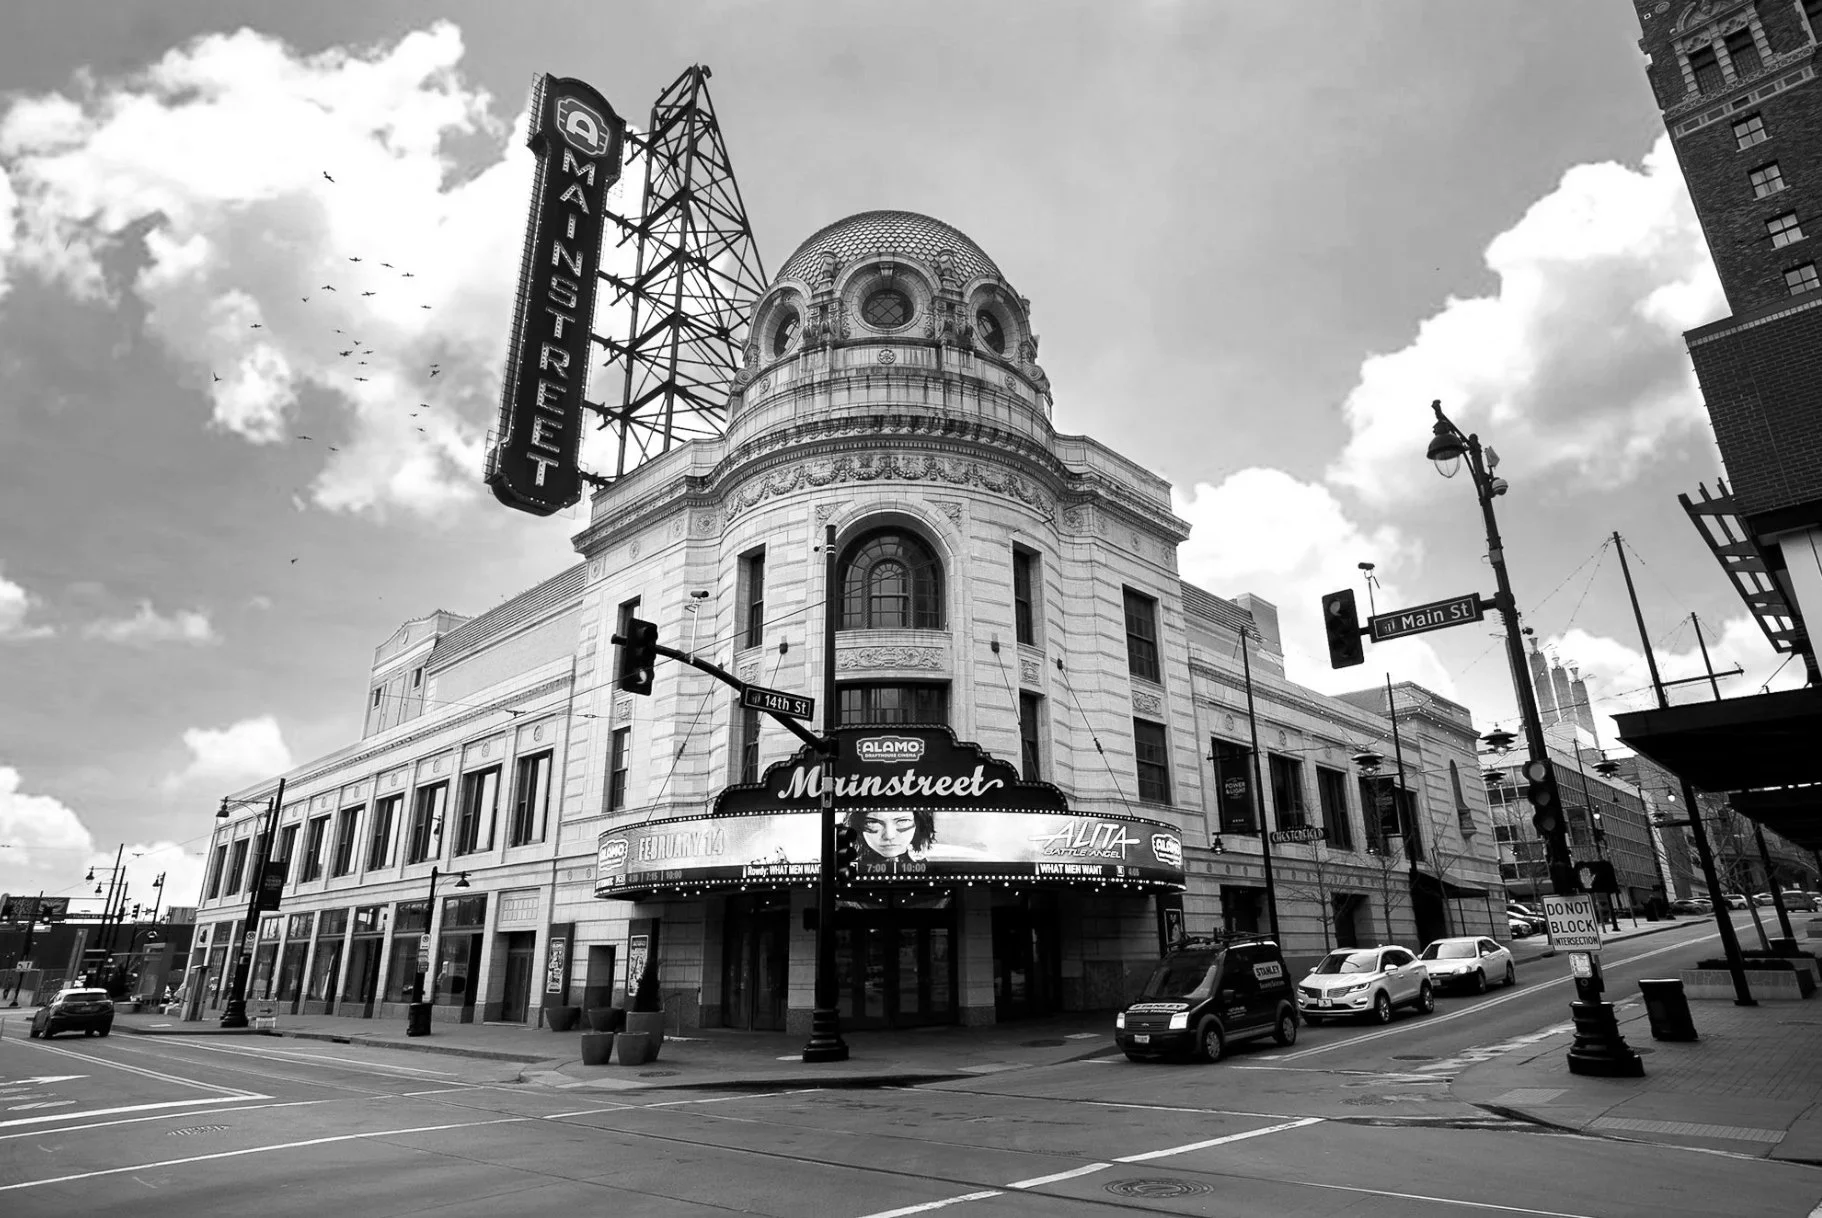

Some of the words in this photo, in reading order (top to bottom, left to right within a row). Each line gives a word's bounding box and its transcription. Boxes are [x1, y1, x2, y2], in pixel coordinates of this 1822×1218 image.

[526, 147, 596, 487] MAINSTREET
[1401, 610, 1444, 630] Main
[1450, 602, 1470, 619] St
[765, 694, 790, 711] 14th
[794, 701, 807, 714] St
[862, 741, 920, 752] ALAMO
[637, 831, 703, 861] FEBRUARY
[703, 829, 725, 857] 14
[1030, 820, 1141, 860] ALITA
[1043, 848, 1087, 857] BATTLE
[1088, 849, 1122, 858] ANGEL
[770, 865, 789, 875] WHAT
[789, 864, 803, 875] MEN
[866, 863, 887, 873] 7:00
[901, 862, 927, 873] 10:00
[1040, 863, 1064, 874] WHAT
[1065, 864, 1082, 875] MEN
[1082, 864, 1103, 875] WANT
[1546, 903, 1564, 916] DO
[1565, 902, 1590, 915] NOT
[1550, 920, 1595, 933] BLOCK
[1553, 935, 1599, 946] INTERSECTION
[1255, 964, 1281, 977] STANLEY
